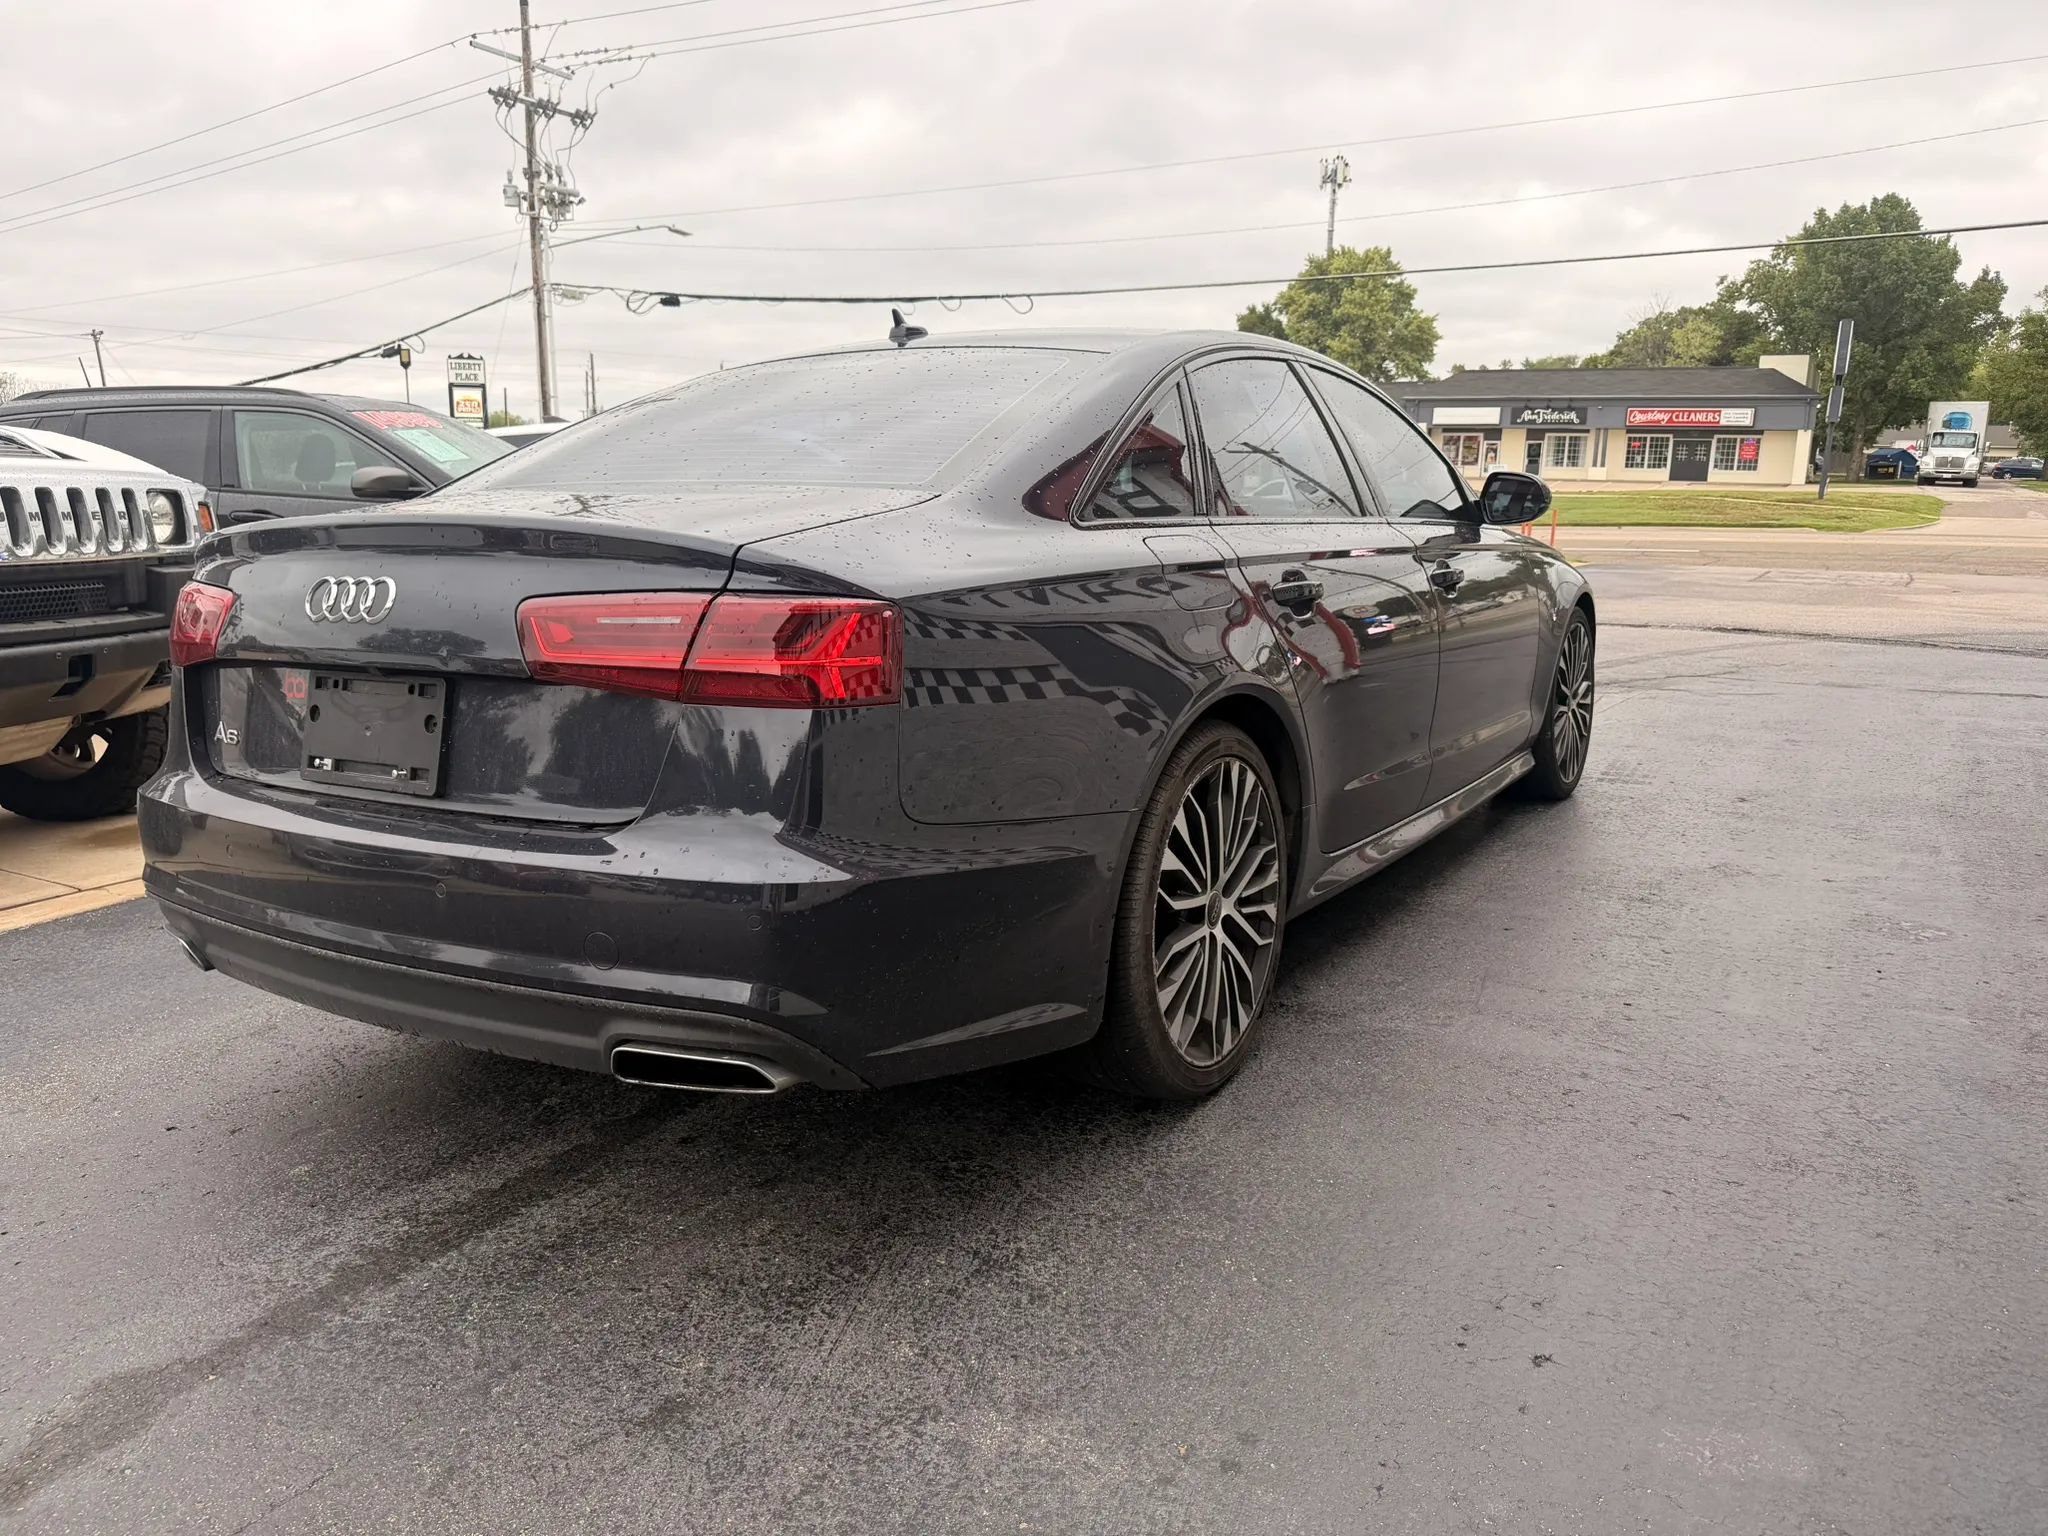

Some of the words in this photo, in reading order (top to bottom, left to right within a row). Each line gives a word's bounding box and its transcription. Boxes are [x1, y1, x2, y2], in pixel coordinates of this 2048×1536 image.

[450, 362, 482, 371] LIBERTY
[455, 372, 479, 381] PLACE
[1517, 409, 1538, 423] Ann
[1629, 410, 1672, 424] Courtesy
[1672, 411, 1720, 422] CLEANERS
[214, 720, 240, 745] A6
